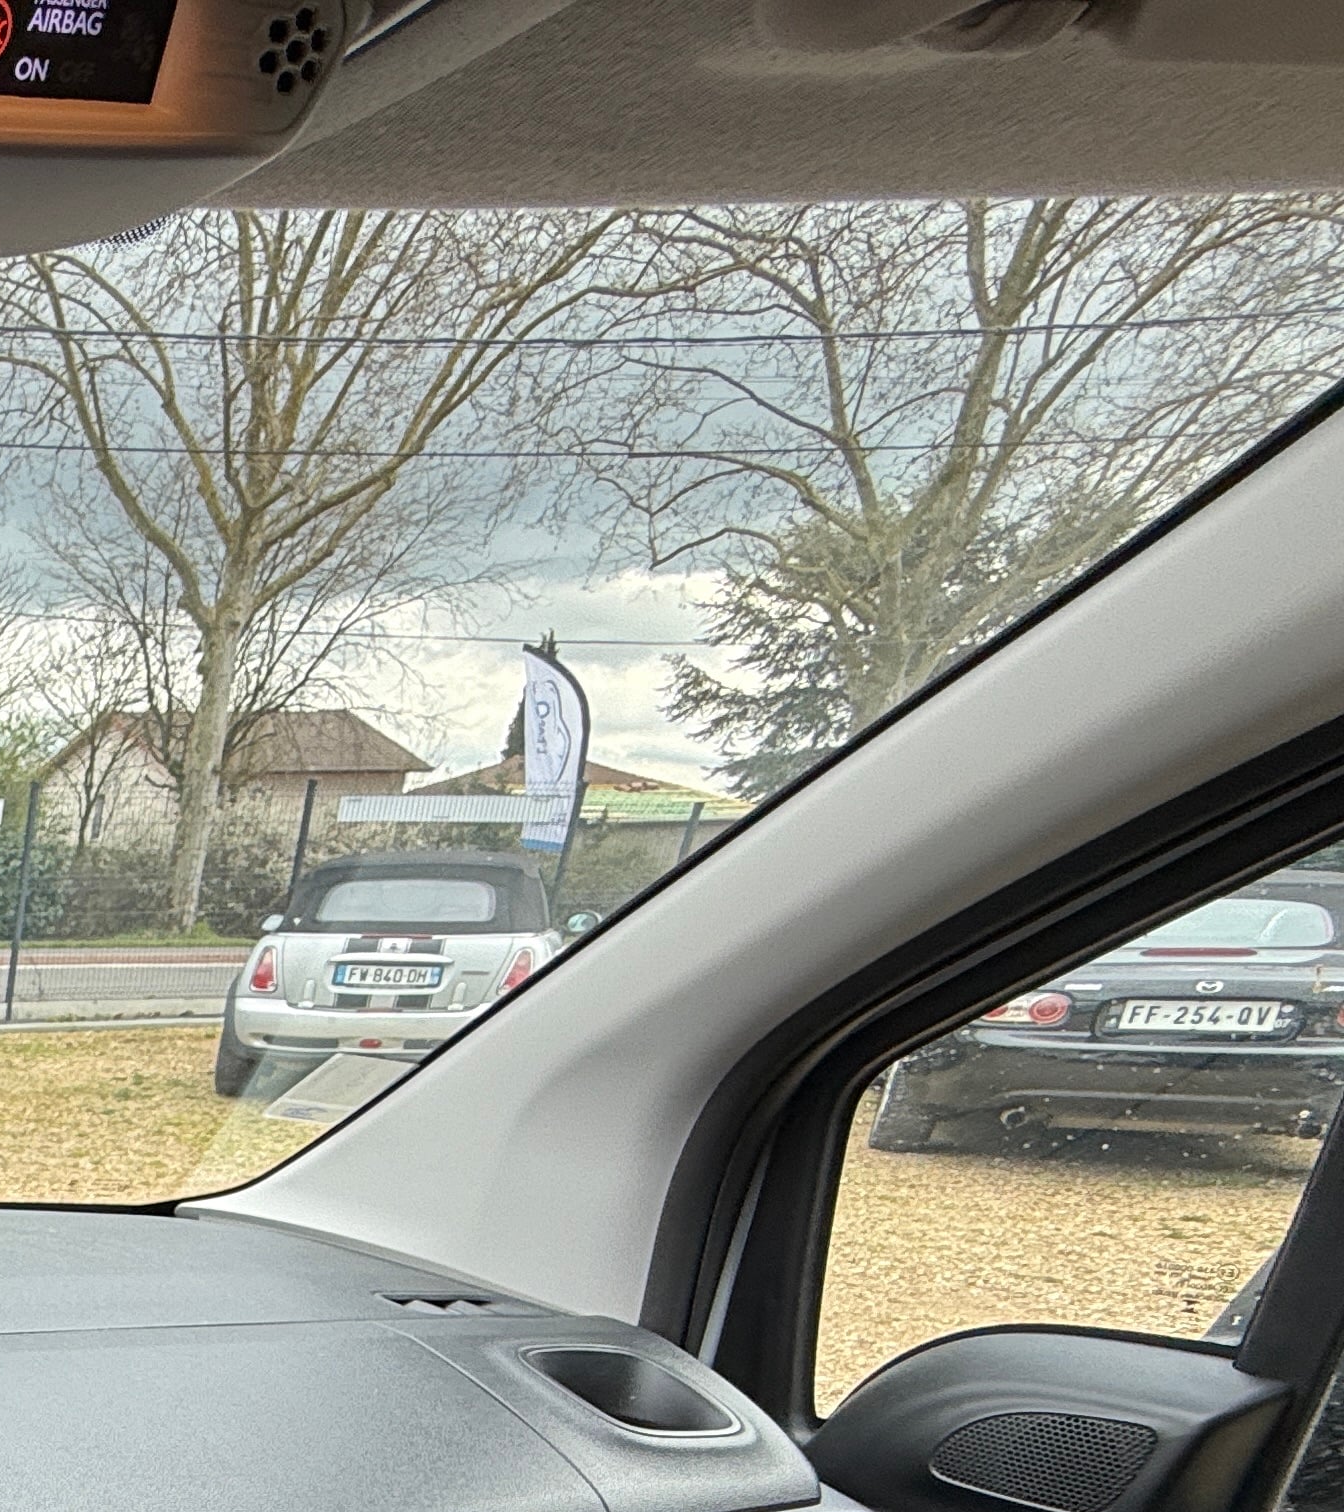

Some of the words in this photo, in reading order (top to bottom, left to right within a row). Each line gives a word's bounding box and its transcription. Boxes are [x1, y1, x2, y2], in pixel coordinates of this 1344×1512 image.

[27, 8, 105, 36] AIRBAG
[14, 56, 50, 81] ON
[1128, 1004, 1273, 1026] FF-254-QV
